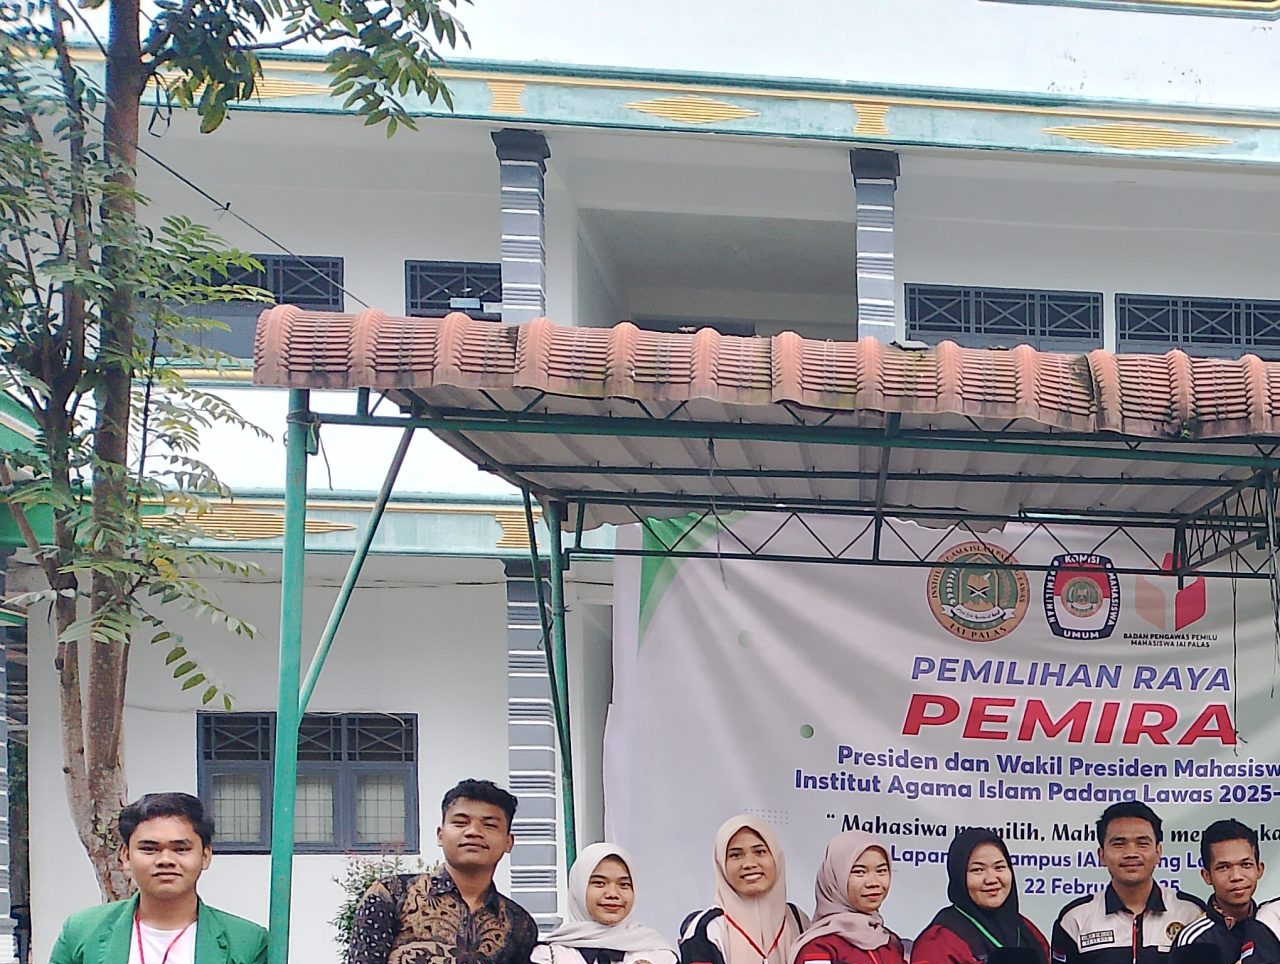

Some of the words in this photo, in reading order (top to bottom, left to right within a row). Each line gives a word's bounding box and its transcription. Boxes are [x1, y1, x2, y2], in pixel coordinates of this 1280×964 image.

[1064, 554, 1100, 565] KOMISI
[1045, 570, 1057, 623] PEMILIHAN
[1107, 572, 1120, 626] MAHASISWA
[1063, 629, 1100, 639] UMUM
[1130, 640, 1175, 648] MAHASISWA
[1150, 633, 1190, 641] PENGAWAS
[911, 656, 1122, 689] PEMILIHAN
[1132, 665, 1231, 691] RAYA
[902, 693, 1238, 745] PEMIRA
[838, 745, 938, 770] Presiden
[945, 752, 989, 773] dan
[996, 754, 1062, 775] Wakil
[1069, 757, 1167, 778] Presiden
[795, 769, 881, 793] Institut
[887, 775, 972, 800] Agama
[979, 780, 1041, 801] Islam
[1048, 783, 1136, 802] Padang
[1143, 785, 1213, 803] Lawas
[841, 814, 947, 837] Mahasiwa
[1009, 854, 1071, 871] ampus
[1024, 878, 1045, 894] 22
